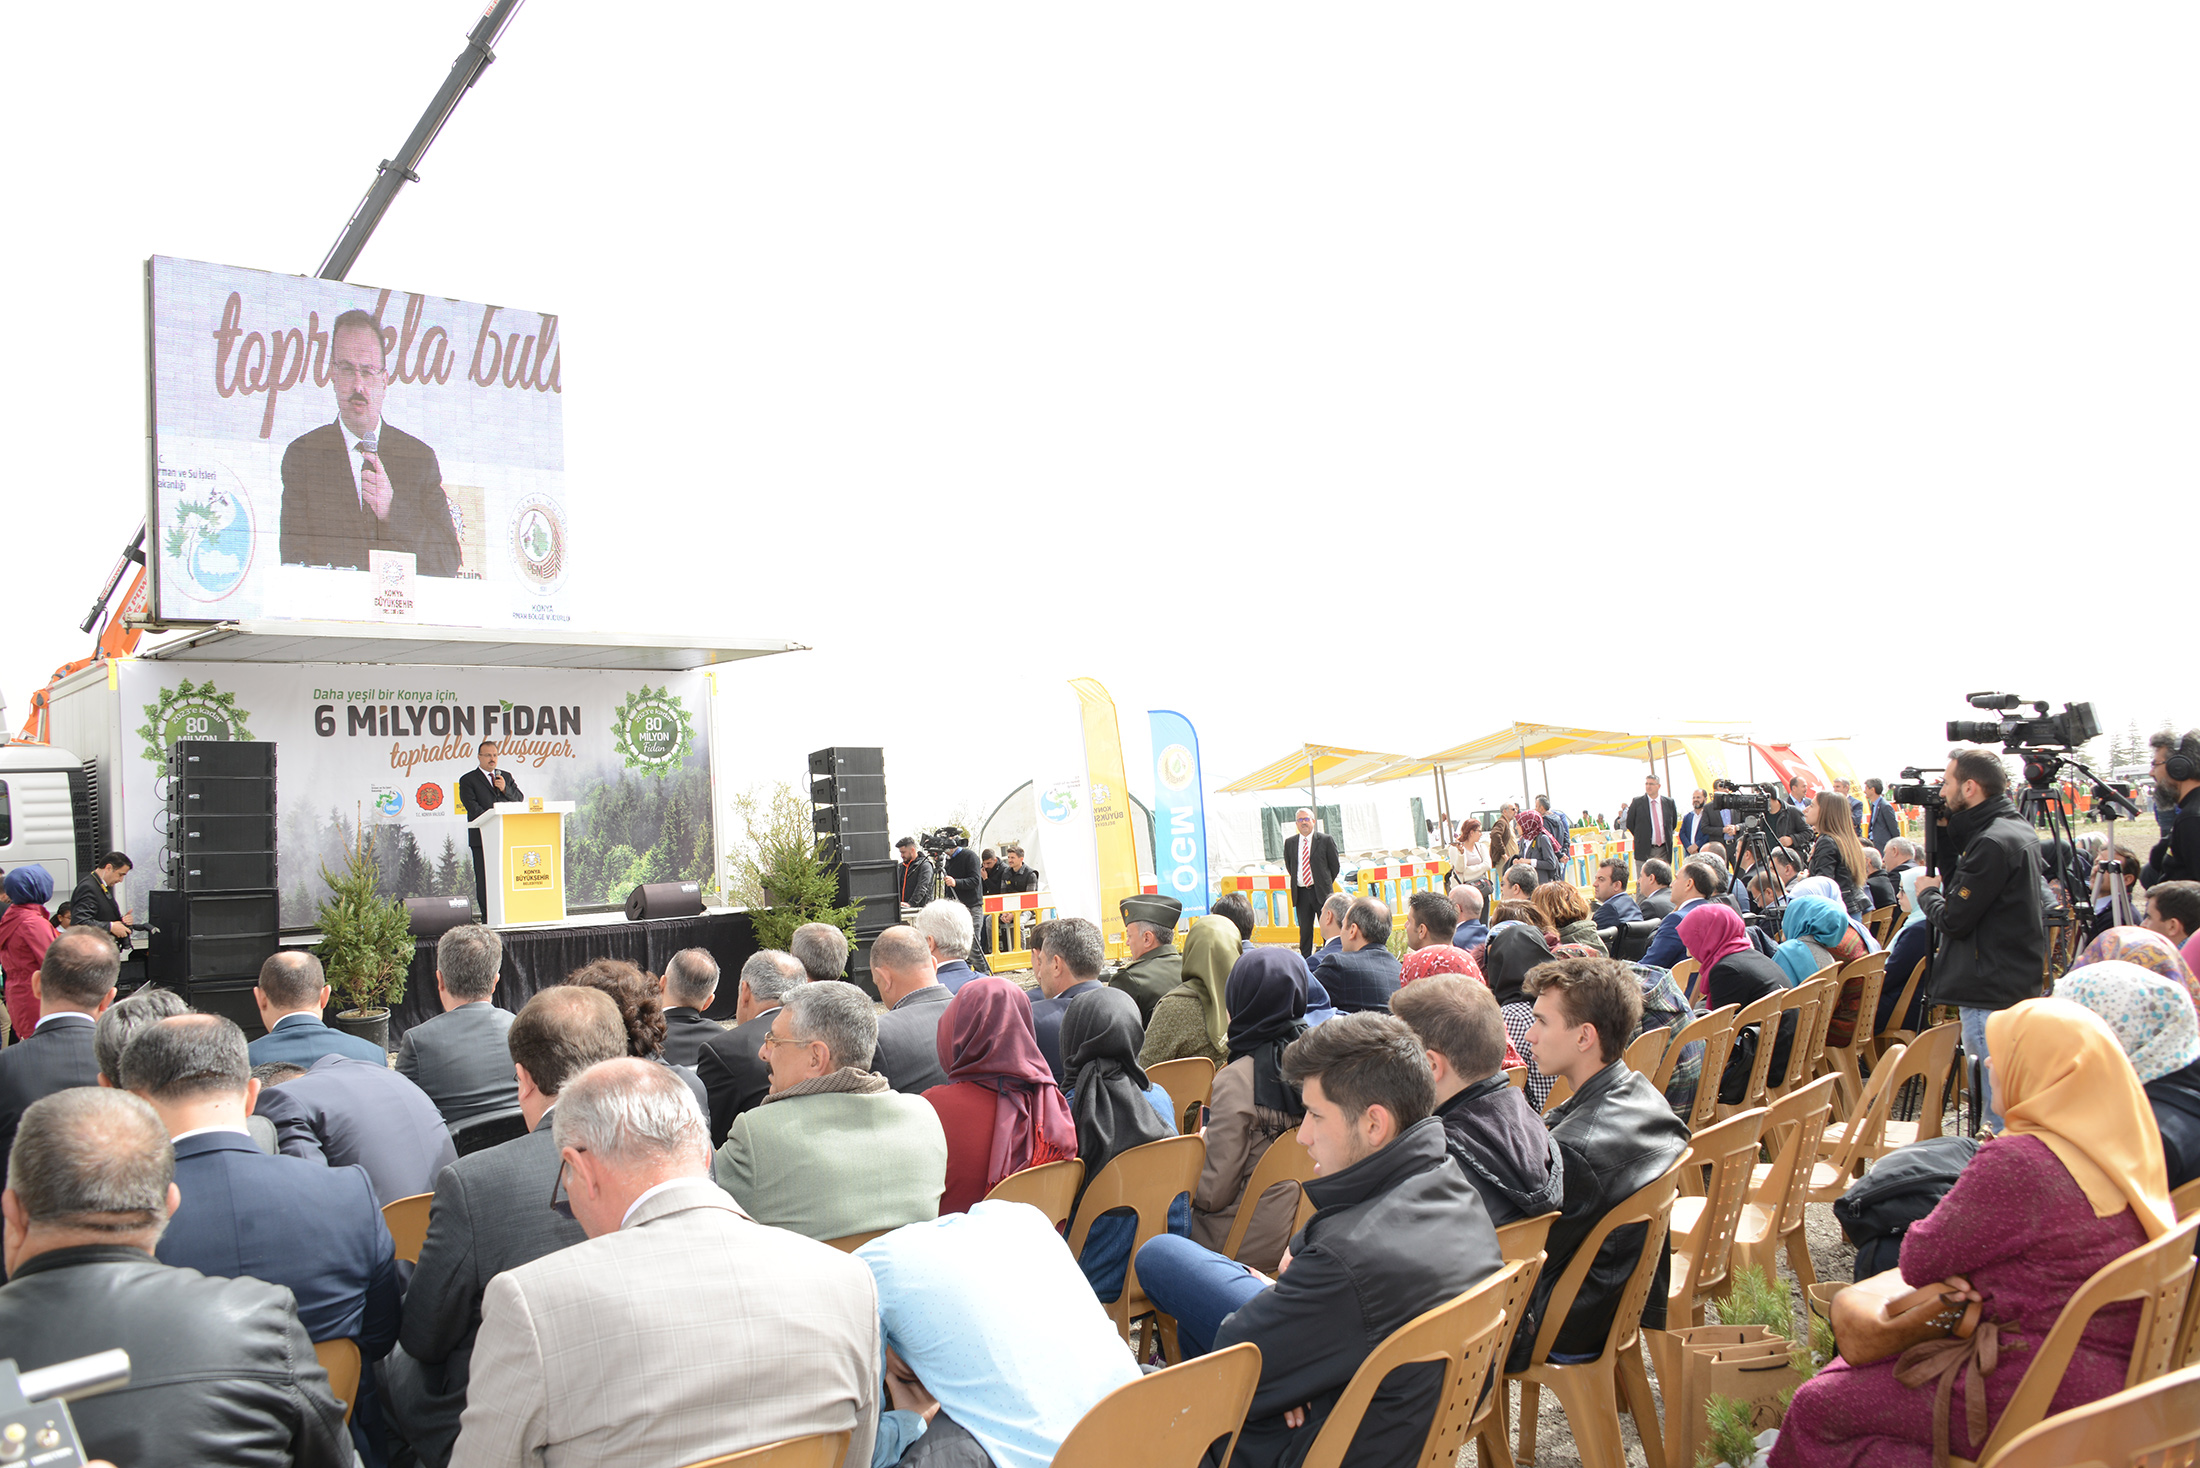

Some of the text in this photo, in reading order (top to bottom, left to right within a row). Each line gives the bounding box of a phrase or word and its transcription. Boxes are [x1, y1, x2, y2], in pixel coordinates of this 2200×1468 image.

[213, 287, 562, 439] toprkla bul
[313, 688, 458, 704] Daha yeşil bir Konya için,
[171, 706, 224, 724] 2023'e kadar
[314, 704, 336, 737] 6
[347, 704, 475, 736] MİLYON
[654, 708, 674, 723] kadar
[185, 717, 209, 733] 80
[645, 717, 662, 731] 80
[639, 730, 670, 742] MİLYON
[390, 732, 473, 778] toprakla
[643, 742, 665, 753] Fidan
